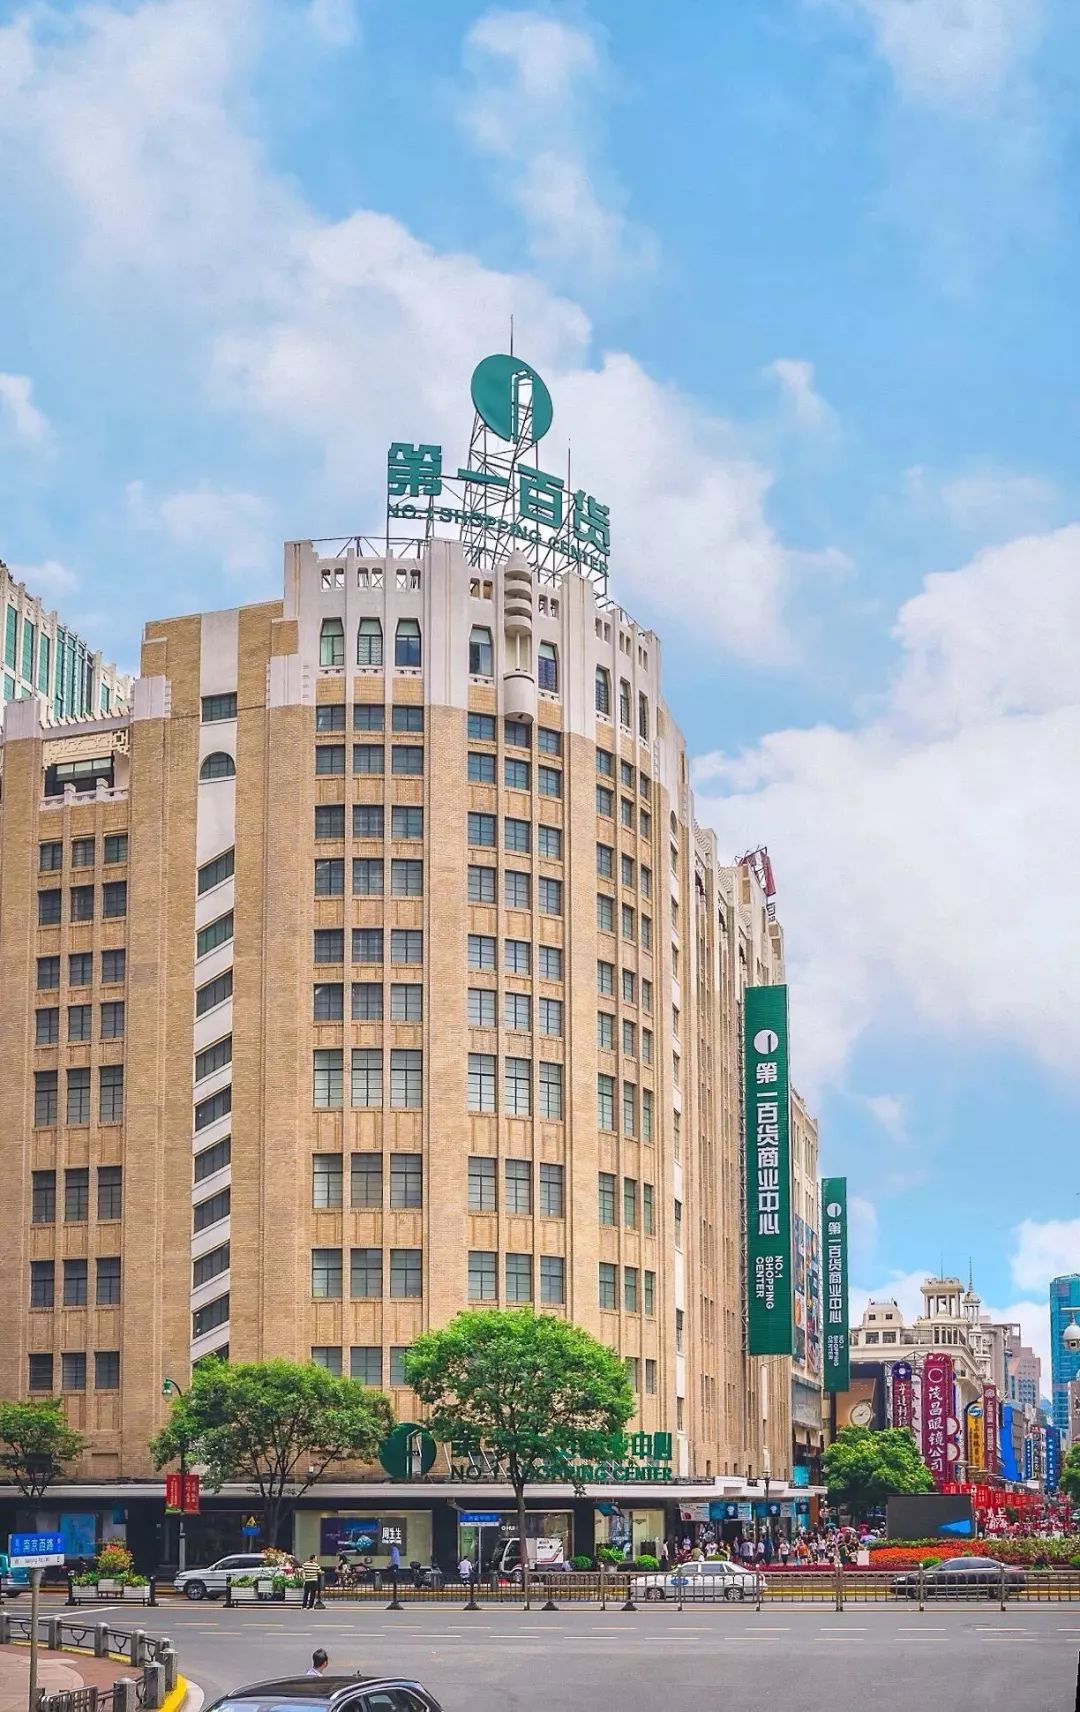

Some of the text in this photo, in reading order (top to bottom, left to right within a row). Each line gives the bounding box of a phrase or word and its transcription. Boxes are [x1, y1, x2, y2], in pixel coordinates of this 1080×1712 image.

[388, 442, 610, 556] 第一百货
[439, 507, 542, 544] SHOPPING
[550, 536, 609, 577] CENTER
[756, 1062, 780, 1235] 第一百货商业中心
[755, 1256, 765, 1298] CENTER
[765, 1256, 775, 1310] SHOPPING
[775, 1255, 784, 1279] NO.1
[828, 1222, 842, 1323] 第一百货商业中心
[613, 1467, 673, 1481] CENTER
